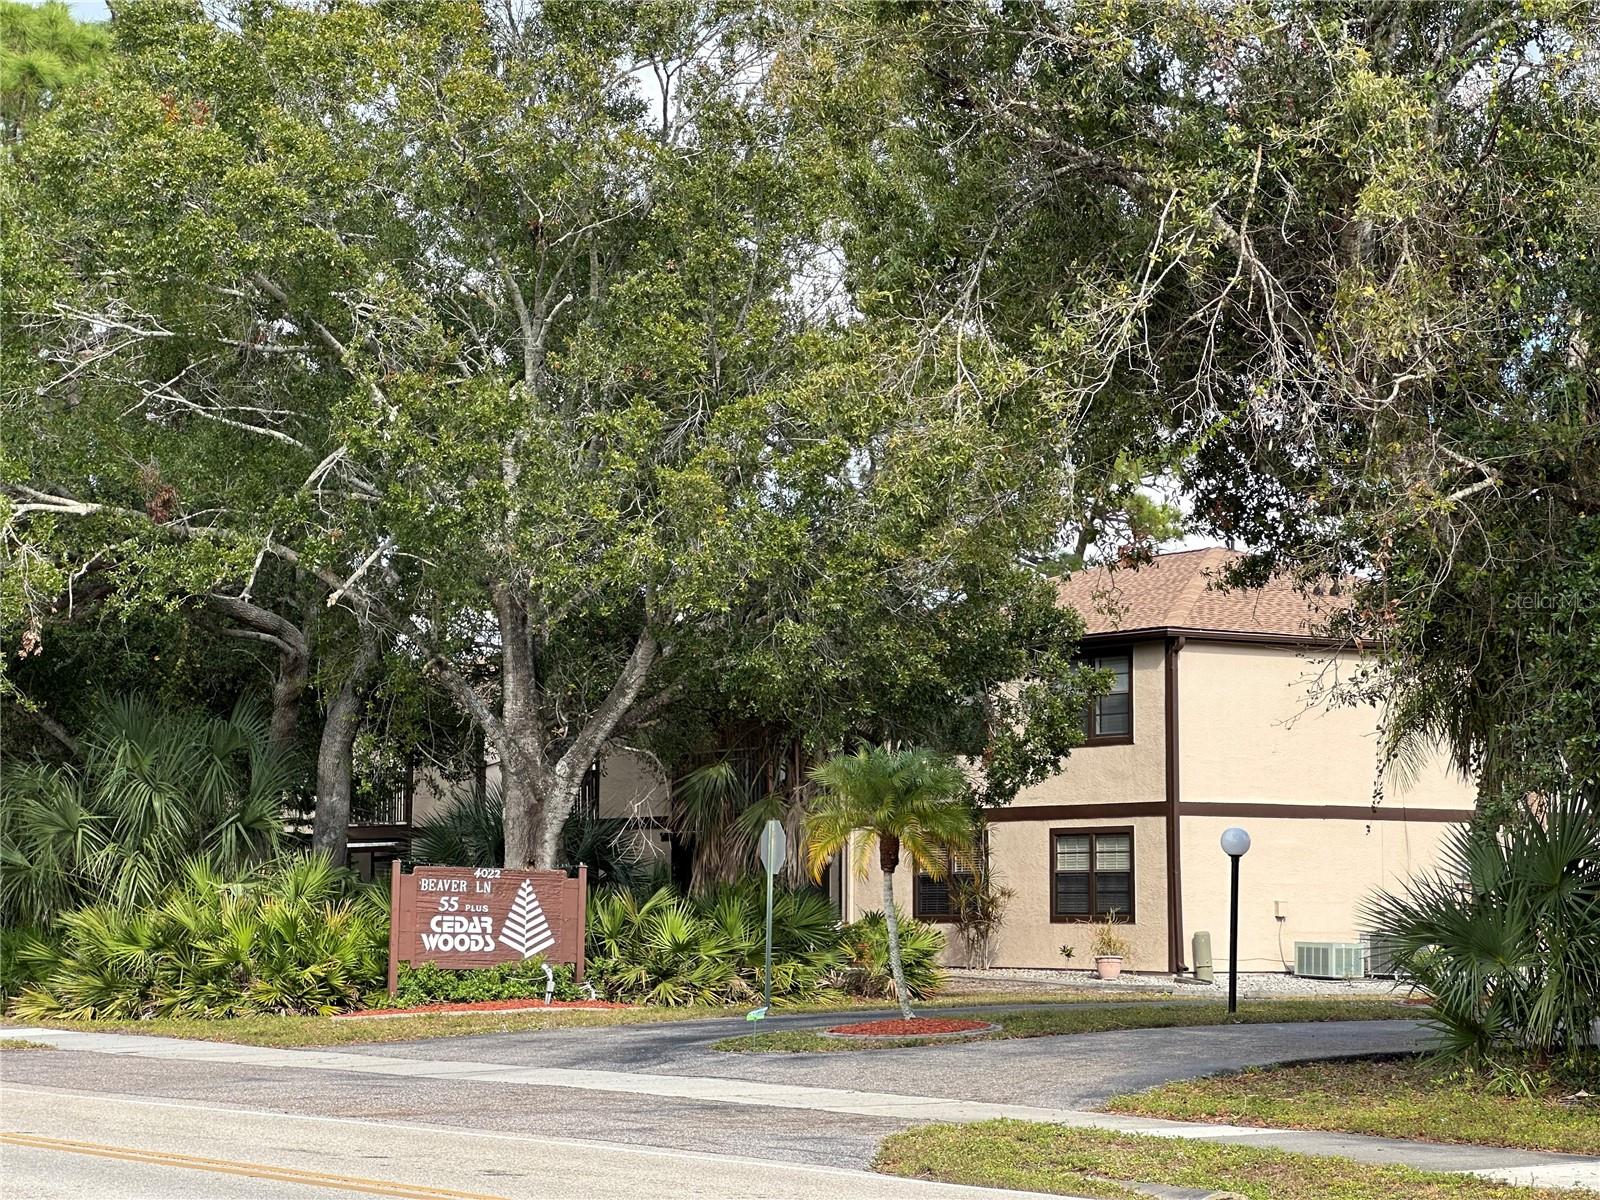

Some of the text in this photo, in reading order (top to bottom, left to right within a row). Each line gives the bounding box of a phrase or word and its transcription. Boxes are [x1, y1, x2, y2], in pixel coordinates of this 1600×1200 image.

[474, 868, 501, 879] 4022
[421, 879, 491, 893] BEAVER LN
[438, 897, 489, 912] 55 PLUS
[430, 916, 493, 934] CEDAR
[421, 934, 496, 952] WOODS
